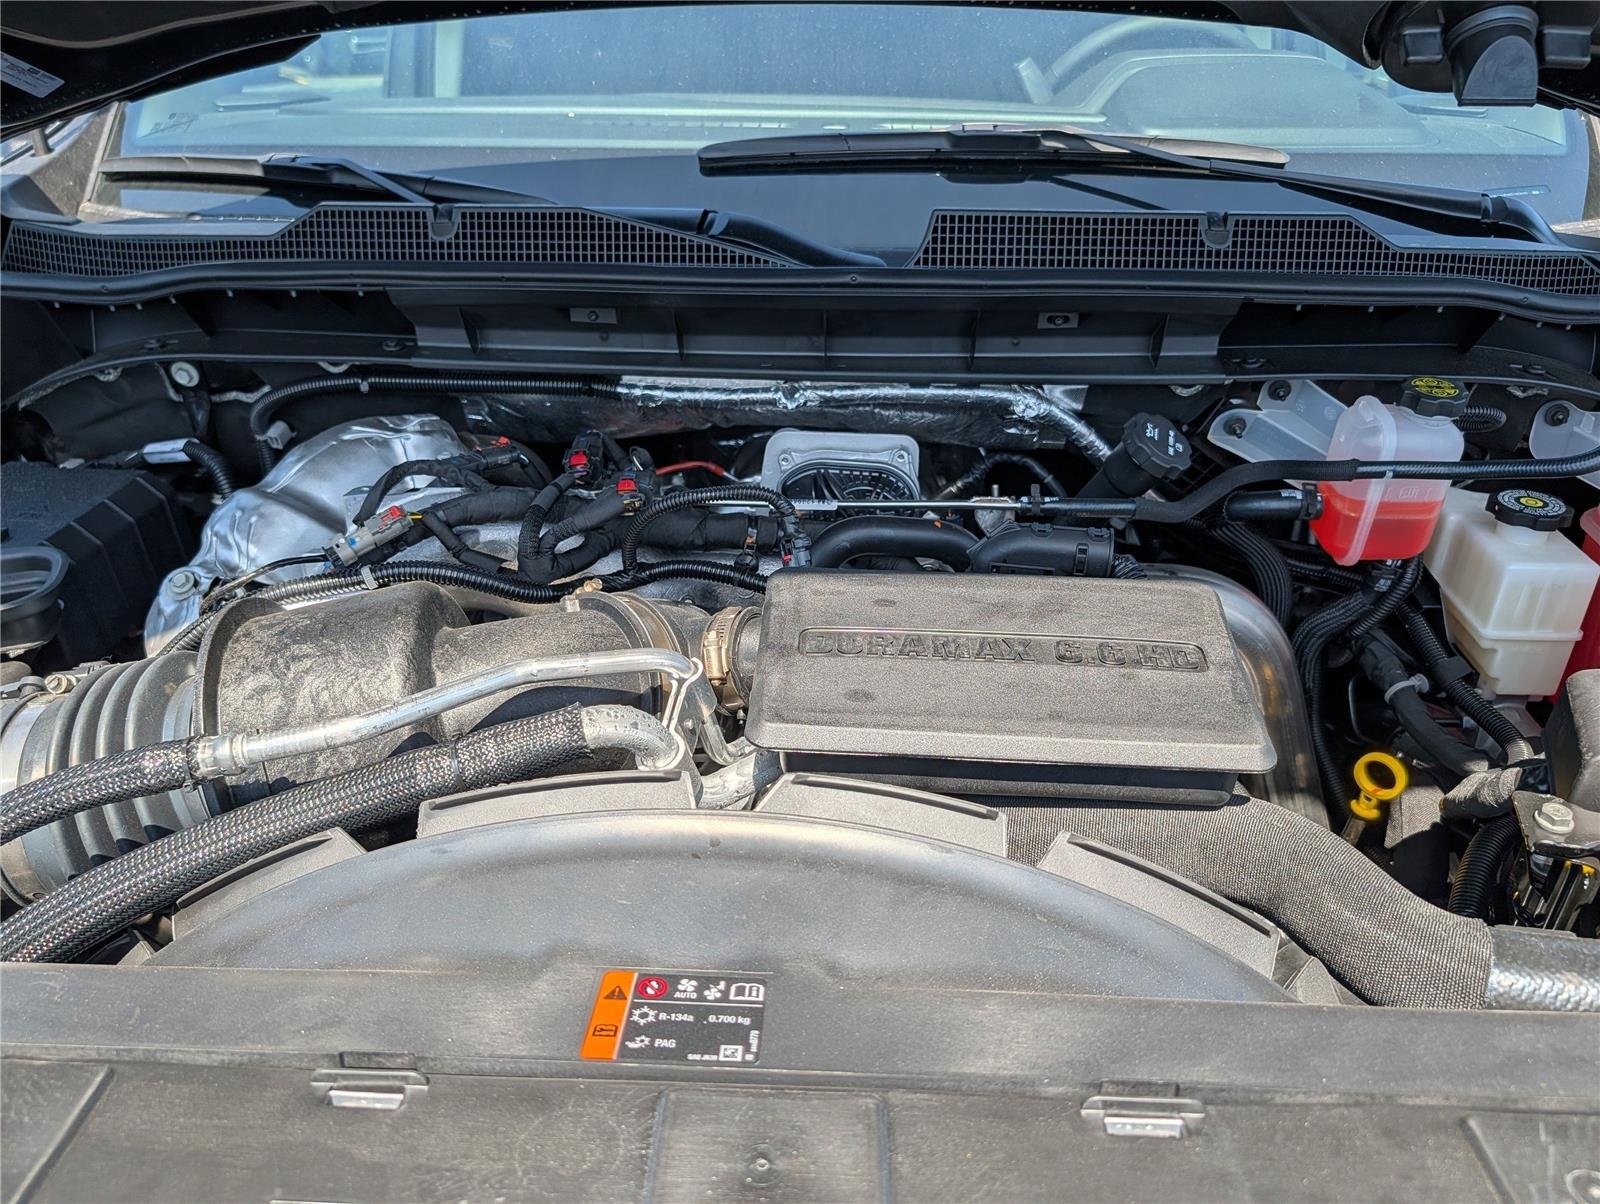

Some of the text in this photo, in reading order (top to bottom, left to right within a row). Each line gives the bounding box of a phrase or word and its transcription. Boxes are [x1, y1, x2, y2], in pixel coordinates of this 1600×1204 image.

[805, 633, 1202, 671] DURAMAX 6.6 HD
[674, 991, 698, 1000] AUTO
[658, 1012, 752, 1026] R-134a 0.700 kg
[655, 1037, 677, 1048] PAG
